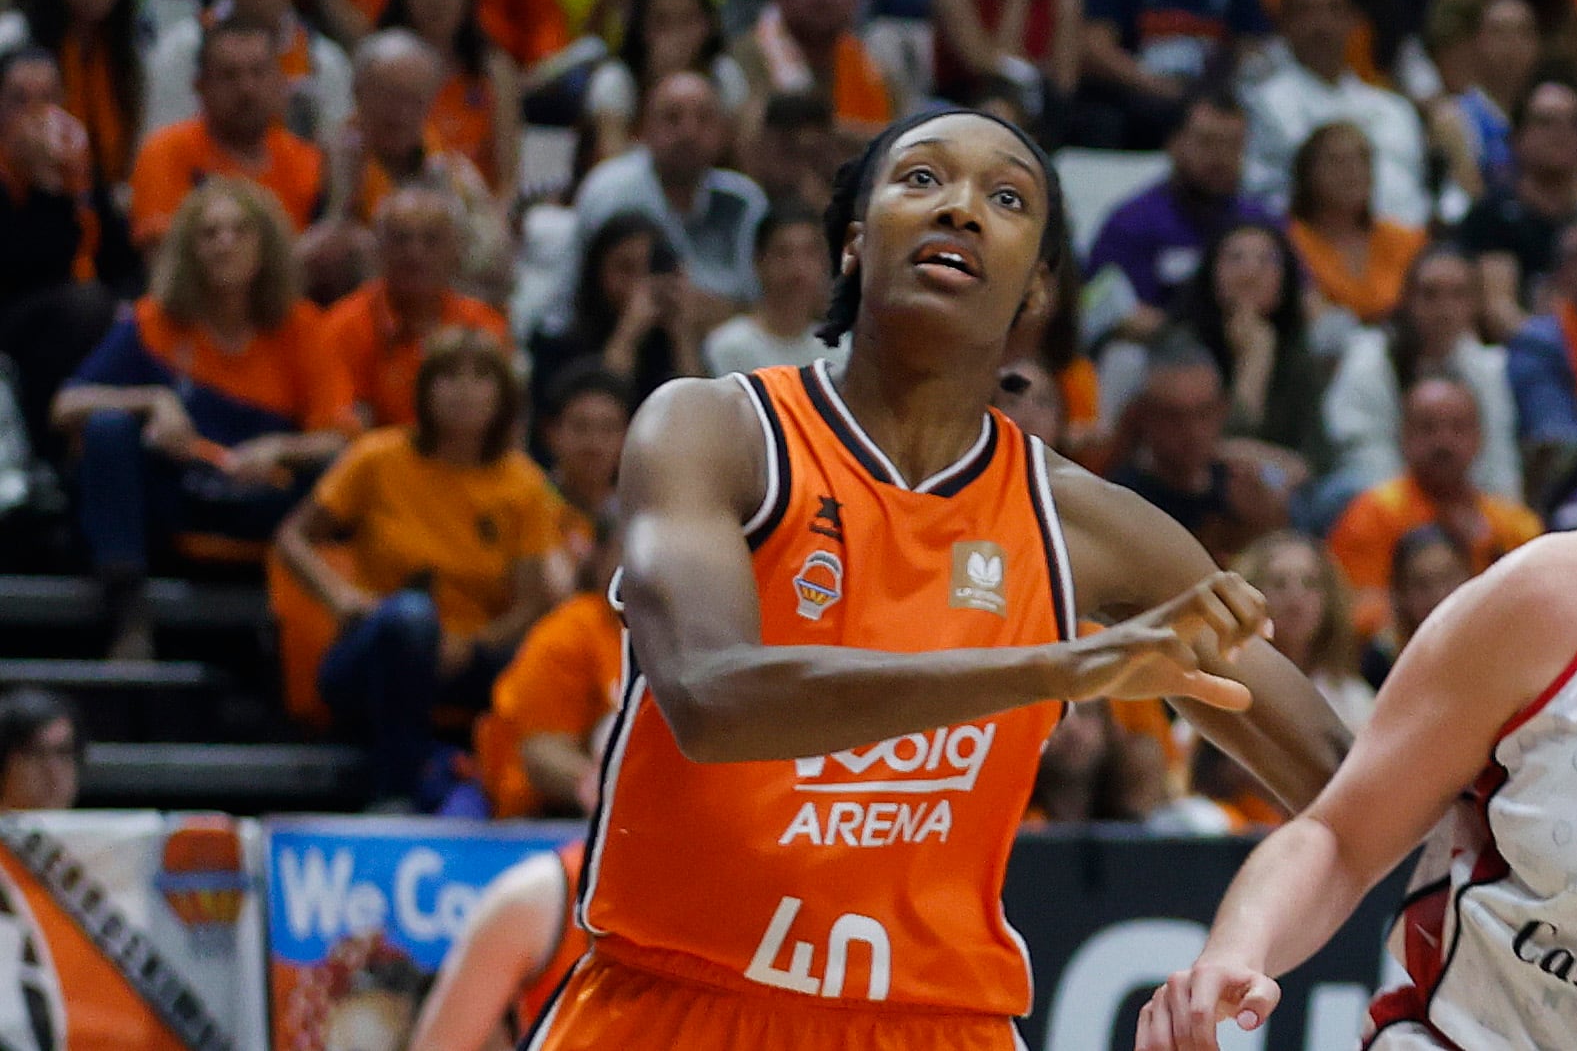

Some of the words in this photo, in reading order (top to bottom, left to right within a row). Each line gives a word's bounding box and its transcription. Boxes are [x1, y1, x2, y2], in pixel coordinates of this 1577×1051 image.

[777, 799, 952, 847] ARENA
[280, 842, 386, 940] We
[743, 895, 892, 1002] 40
